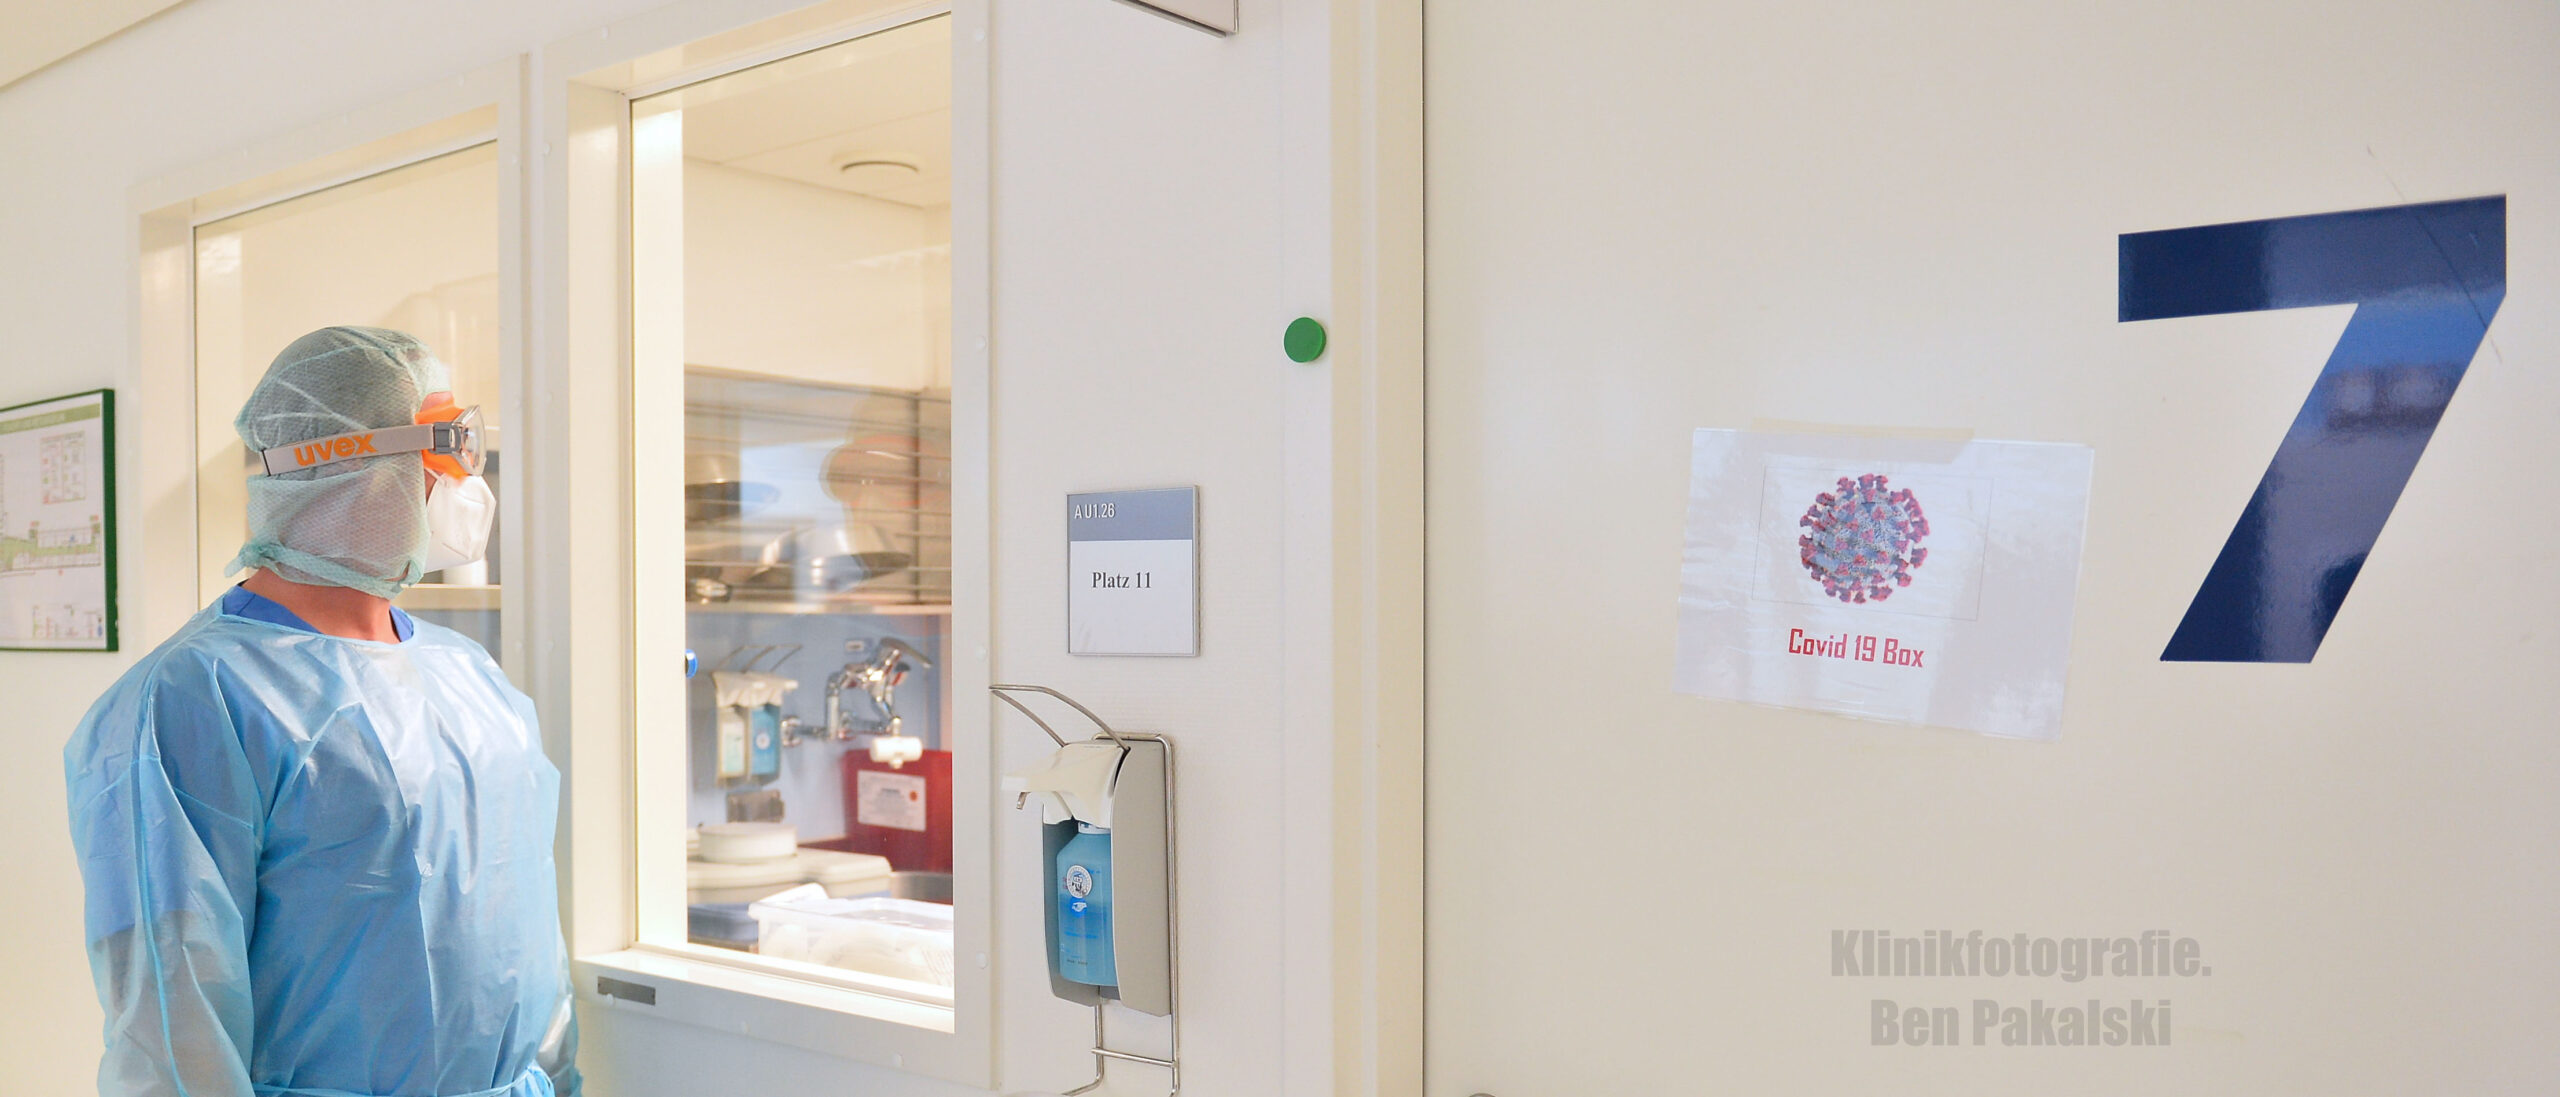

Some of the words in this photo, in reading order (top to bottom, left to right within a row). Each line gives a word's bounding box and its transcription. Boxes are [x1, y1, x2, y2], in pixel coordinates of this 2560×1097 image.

[2118, 193, 2507, 664] 7
[293, 433, 377, 466] uvex
[1092, 571, 1130, 589] Platz
[1136, 571, 1152, 589] 11
[1788, 628, 1847, 659] Covid
[1855, 635, 1877, 662] 19
[1882, 638, 1924, 667] Box
